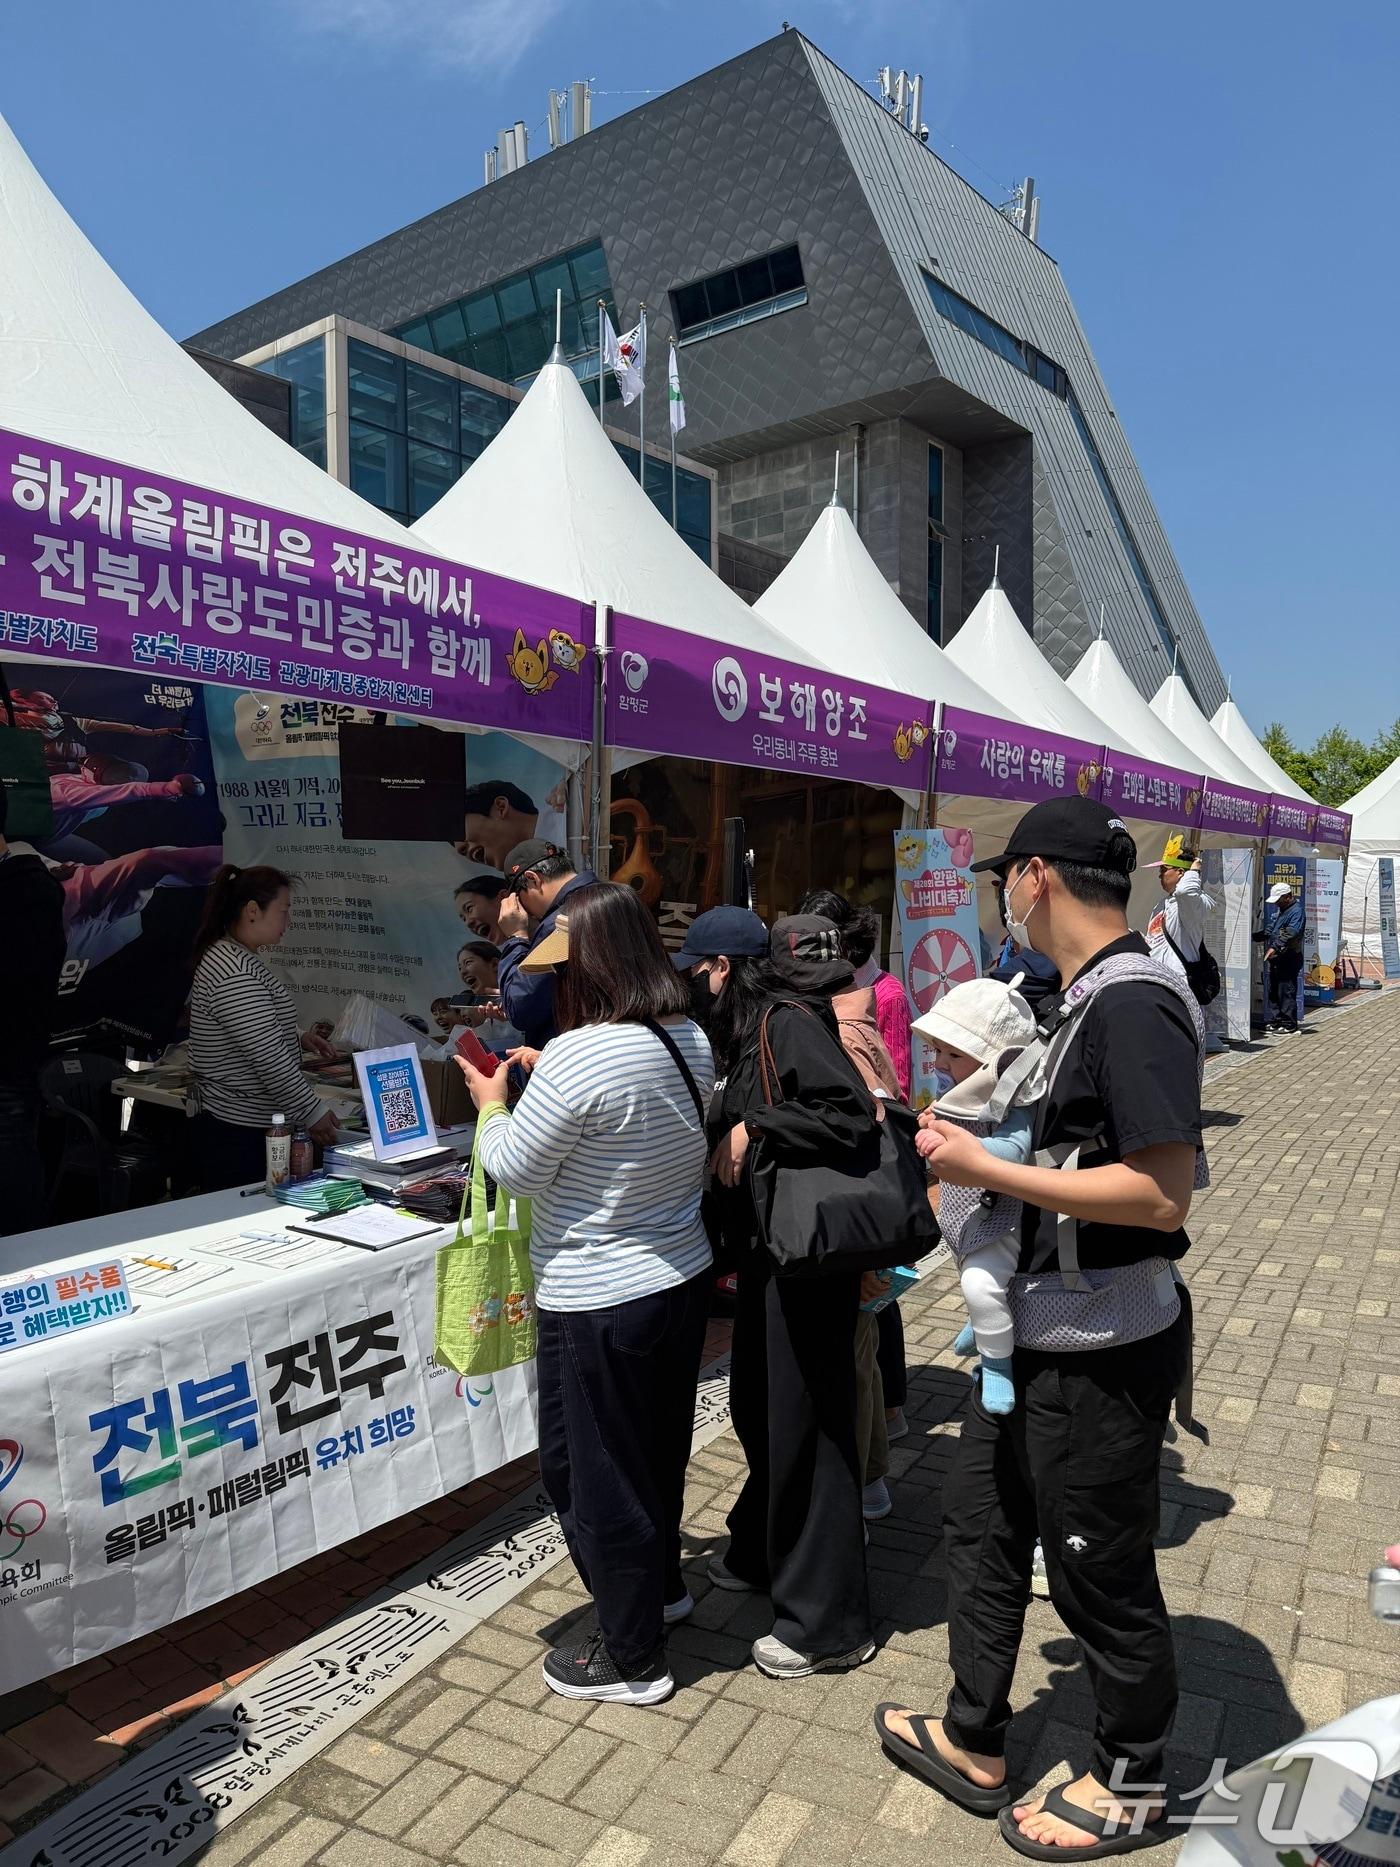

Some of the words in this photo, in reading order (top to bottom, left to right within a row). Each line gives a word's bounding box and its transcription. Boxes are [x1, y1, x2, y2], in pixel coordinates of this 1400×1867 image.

[11, 453, 315, 585] 하계올림픽은
[331, 542, 481, 628] 전주에서,
[31, 533, 414, 671] 전북사랑도민증과
[426, 626, 490, 686] 함께
[131, 631, 271, 681] 전북특별자치도
[279, 660, 433, 709] 관광마케팅종합지원센터
[144, 694, 156, 705] 더
[151, 684, 162, 695] 더
[618, 694, 649, 714] 함평군
[280, 701, 319, 728] 전북
[759, 673, 868, 741] 보해양조
[752, 733, 795, 761] 우리동네
[798, 742, 818, 765] 주류
[819, 746, 839, 768] 홍보
[980, 737, 1024, 782] 사랑의
[1028, 746, 1066, 789] 우체통
[220, 782, 249, 797] 1988
[255, 778, 289, 798] 서울의
[297, 777, 324, 796] 기적,
[1122, 770, 1145, 803] 모바일
[239, 804, 288, 828] 그리고
[294, 802, 331, 827] 지금,
[914, 880, 934, 888] 제28회
[933, 870, 957, 887] 함평
[1274, 864, 1297, 874] 고유가
[911, 889, 971, 907] 나비대축제
[0, 1283, 49, 1317] 행의
[55, 1265, 121, 1301] 필수품
[23, 1291, 127, 1338] 혜택받자!!
[429, 1368, 447, 1379] KOREA
[89, 1360, 258, 1507] 전북
[265, 1310, 407, 1435] 전주
[104, 1448, 312, 1564] 올림픽·패럴림픽
[315, 1429, 365, 1471] 유치
[368, 1405, 416, 1449] 희망
[508, 1545, 556, 1578] 2008
[20, 1573, 74, 1597] Committee
[151, 1791, 232, 1856] 2008
